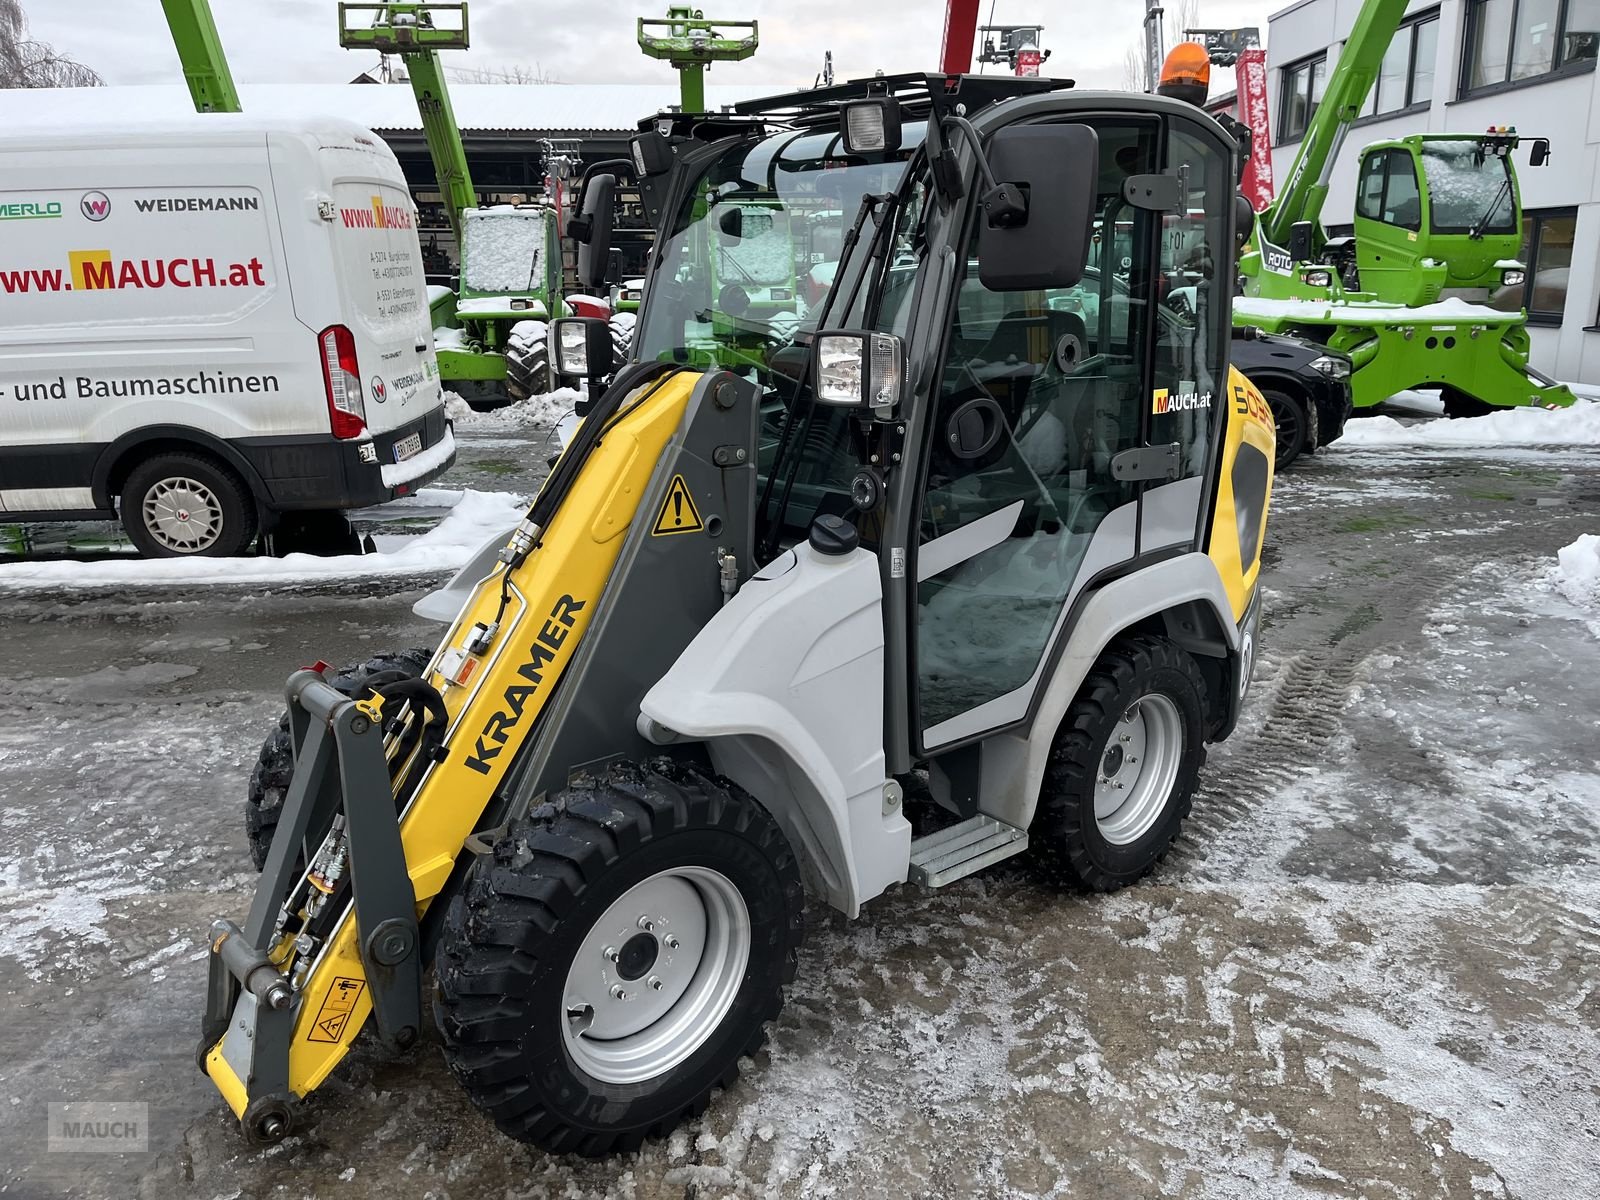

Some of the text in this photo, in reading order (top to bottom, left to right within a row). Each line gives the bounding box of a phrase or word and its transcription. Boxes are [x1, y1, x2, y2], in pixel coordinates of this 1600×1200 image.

[134, 197, 258, 212] WEIDEMANN
[14, 371, 280, 401] und Baumaschinen
[1157, 391, 1211, 413] MAUCH.at
[464, 594, 586, 775] KRAMER
